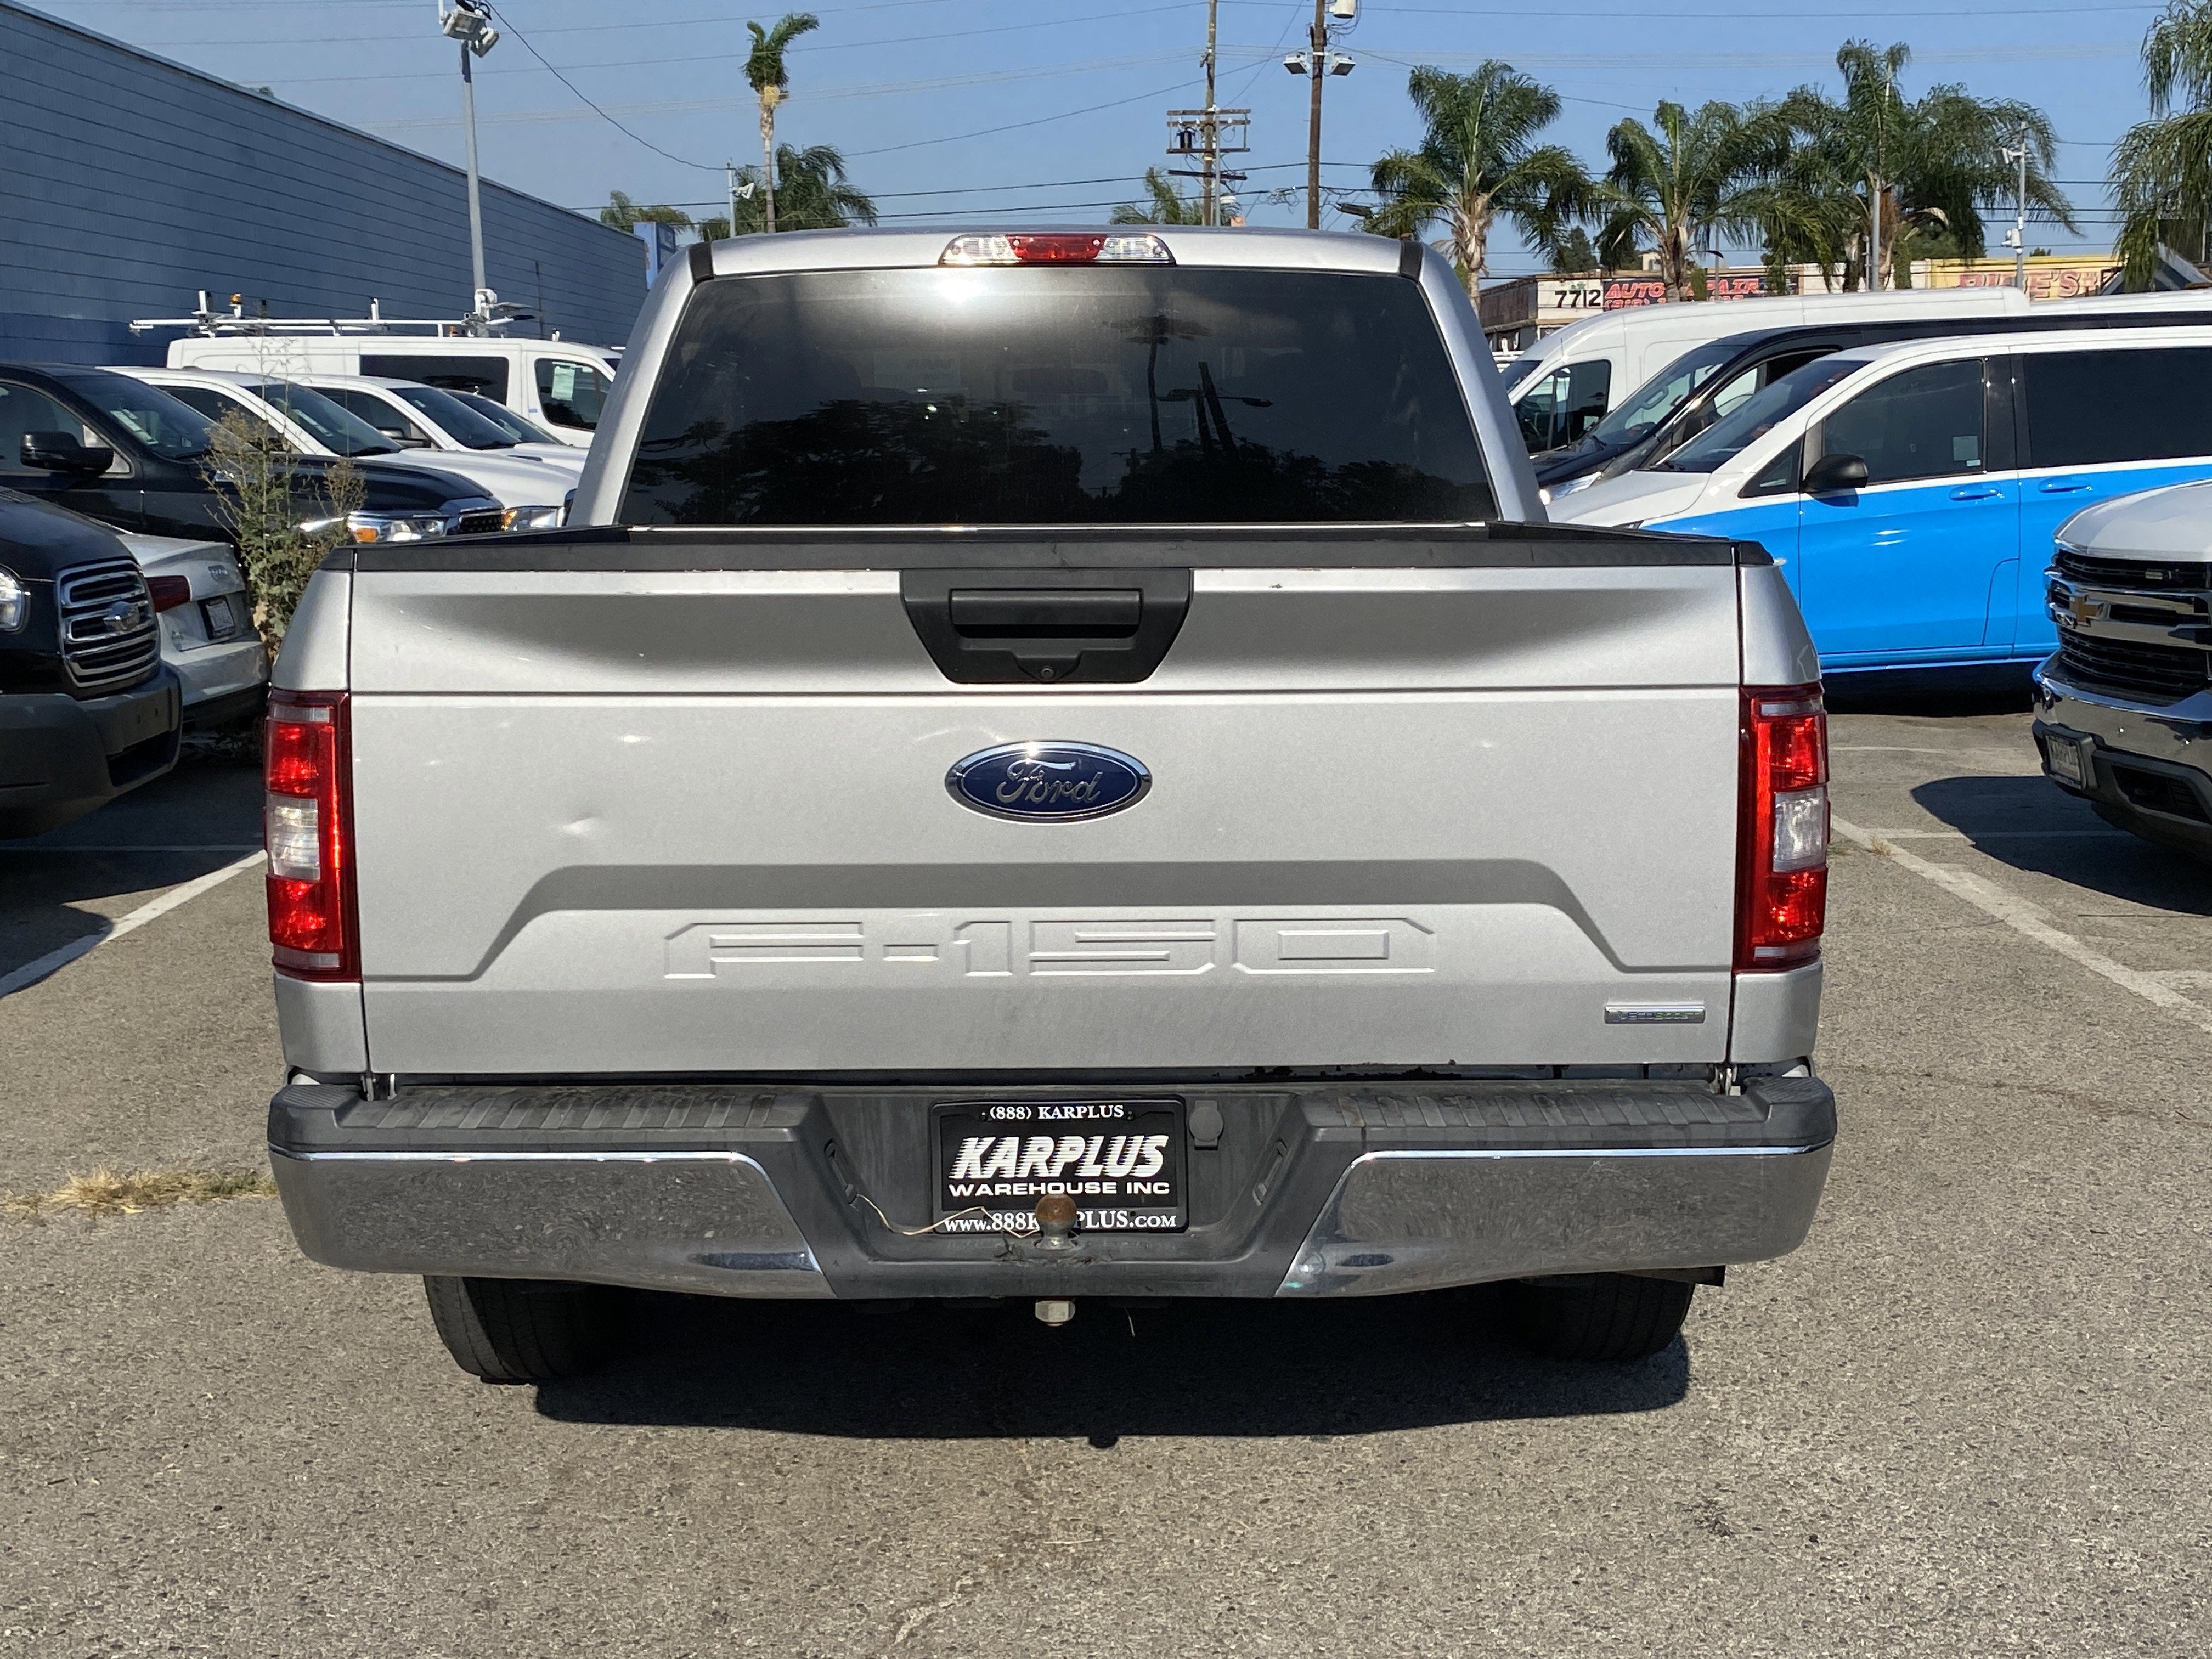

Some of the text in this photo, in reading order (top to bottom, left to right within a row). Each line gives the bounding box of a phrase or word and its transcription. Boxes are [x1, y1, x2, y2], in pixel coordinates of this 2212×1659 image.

[1555, 289, 1601, 308] 7712
[1604, 281, 1666, 300] AUTO
[1685, 278, 1760, 297] PAIR
[995, 759, 1103, 804] Ford
[664, 917, 1436, 979] F-150
[989, 1104, 1124, 1120] (888) KARPLUS
[948, 1135, 1169, 1179] KARPLUS
[949, 1181, 1170, 1197] WAREHOUSE INC
